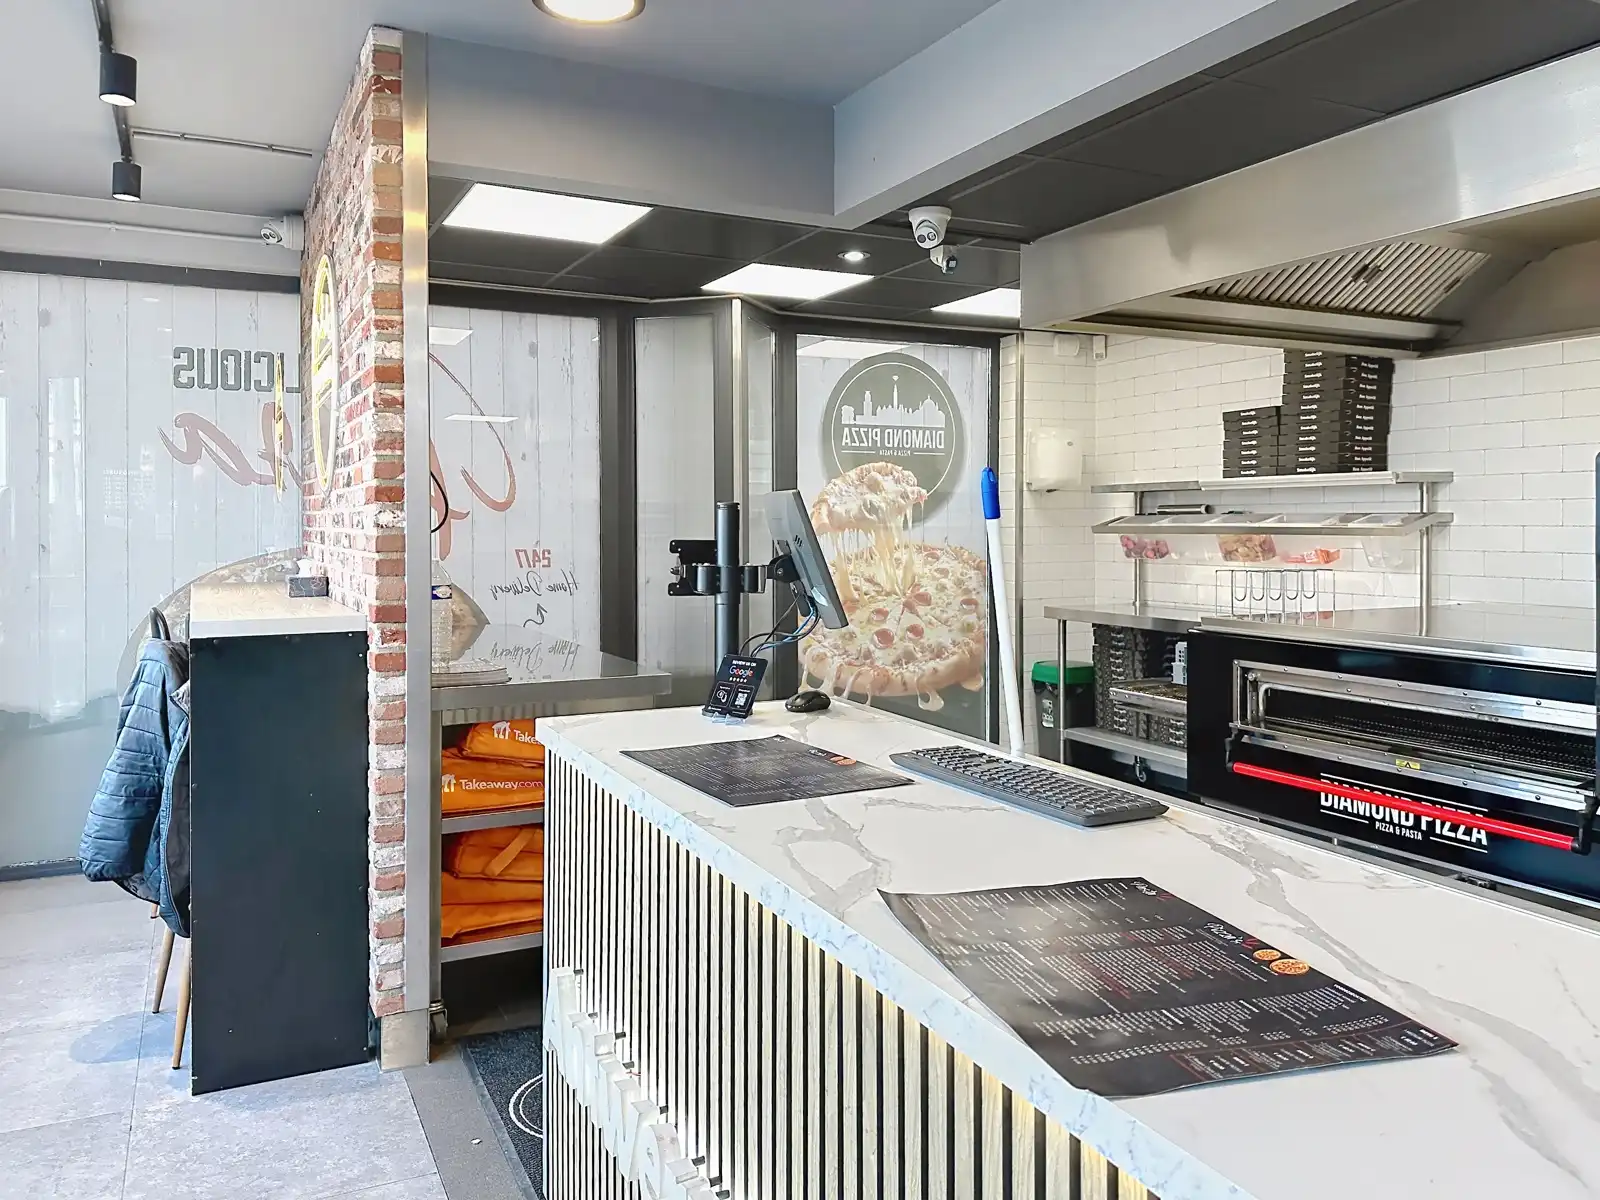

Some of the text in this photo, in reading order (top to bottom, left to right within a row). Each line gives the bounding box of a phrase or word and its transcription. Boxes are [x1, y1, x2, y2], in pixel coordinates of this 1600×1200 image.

[729, 665, 754, 678] Google
[513, 729, 542, 745] Take
[459, 779, 543, 790] Takeaway.com
[1375, 821, 1422, 841] PIZZA & PASTA
